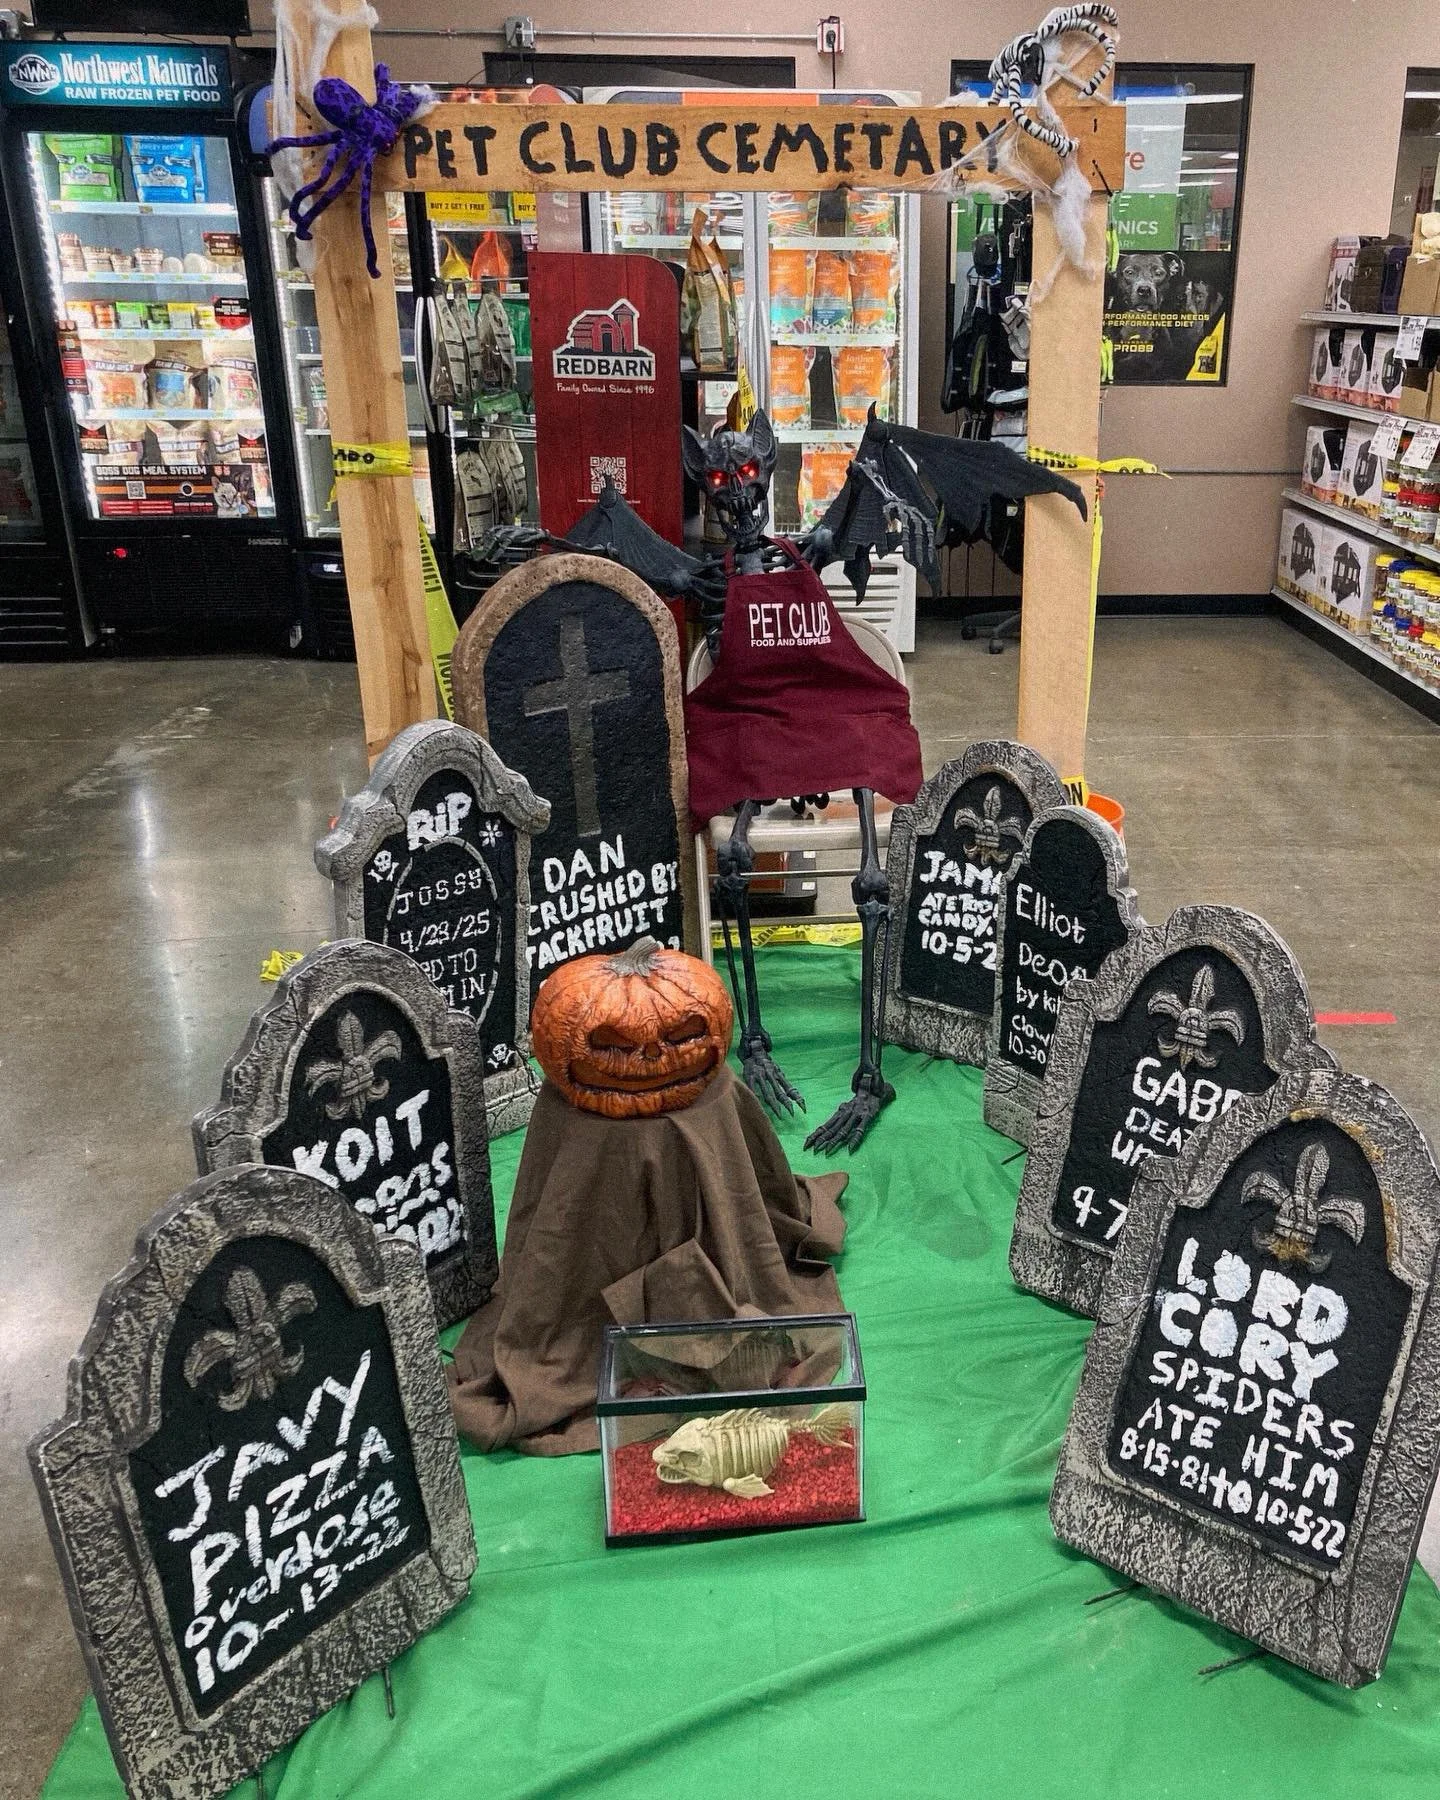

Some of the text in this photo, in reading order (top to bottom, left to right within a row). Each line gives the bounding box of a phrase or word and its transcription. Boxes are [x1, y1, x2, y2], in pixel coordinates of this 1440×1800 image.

[60, 52, 219, 87] Northwest Naturals
[64, 87, 221, 102] RAW FROZEN PET FOOD
[404, 116, 1007, 179] PET CLUB CEMETARY
[469, 203, 485, 211] FREE
[518, 203, 531, 211] BUY
[1116, 220, 1159, 235] NICS
[1102, 313, 1211, 321] RFORMANCE DOG NEEDS
[1174, 320, 1195, 328] DIET
[556, 357, 653, 378] REDBARN
[556, 382, 655, 395] Family Owned Since 1996
[96, 466, 120, 476] BOSS
[143, 465, 167, 475] MEAL
[170, 465, 207, 476] SYSTEM
[748, 601, 831, 639] PET CLUB
[751, 635, 832, 647] FOOD AND SUPPLIES
[543, 833, 626, 894] DAN
[651, 861, 678, 895] BY
[921, 891, 958, 913] ATE
[1015, 882, 1087, 945] Elliot
[1176, 1237, 1350, 1345] LORD
[1159, 1291, 1340, 1402] CORY
[1148, 1350, 1355, 1461] SPIDERS
[1138, 1397, 1340, 1507] ATE HIM
[189, 1425, 395, 1617] PIZZA
